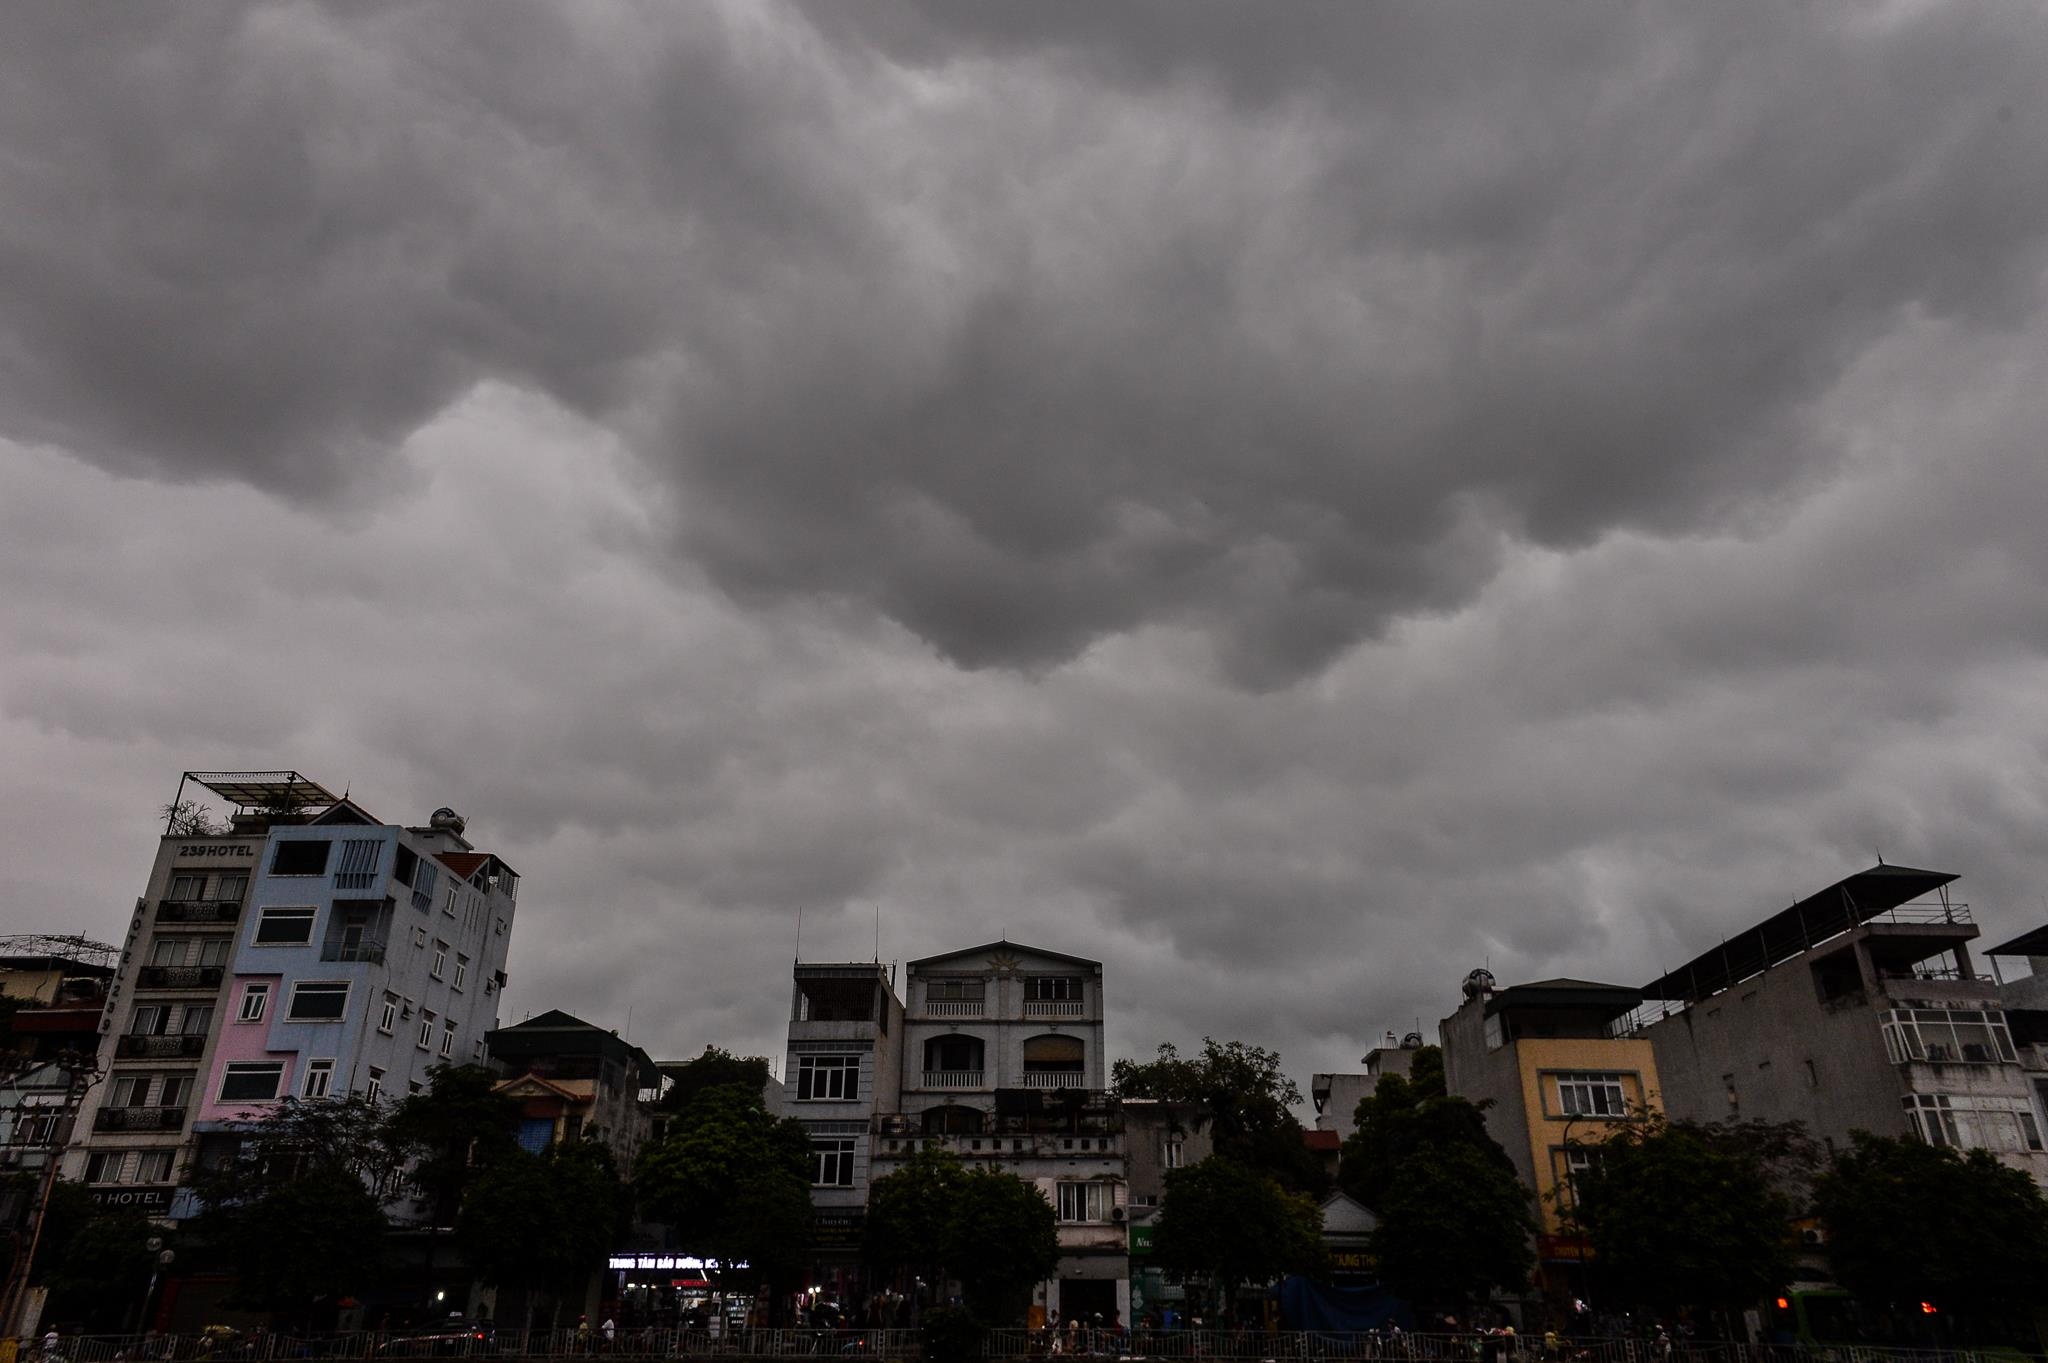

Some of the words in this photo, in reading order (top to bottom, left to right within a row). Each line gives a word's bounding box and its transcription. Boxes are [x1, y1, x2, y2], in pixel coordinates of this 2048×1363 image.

[116, 902, 147, 981] HOTEL
[101, 985, 121, 1032] 239
[107, 1192, 166, 1205] HOTEL
